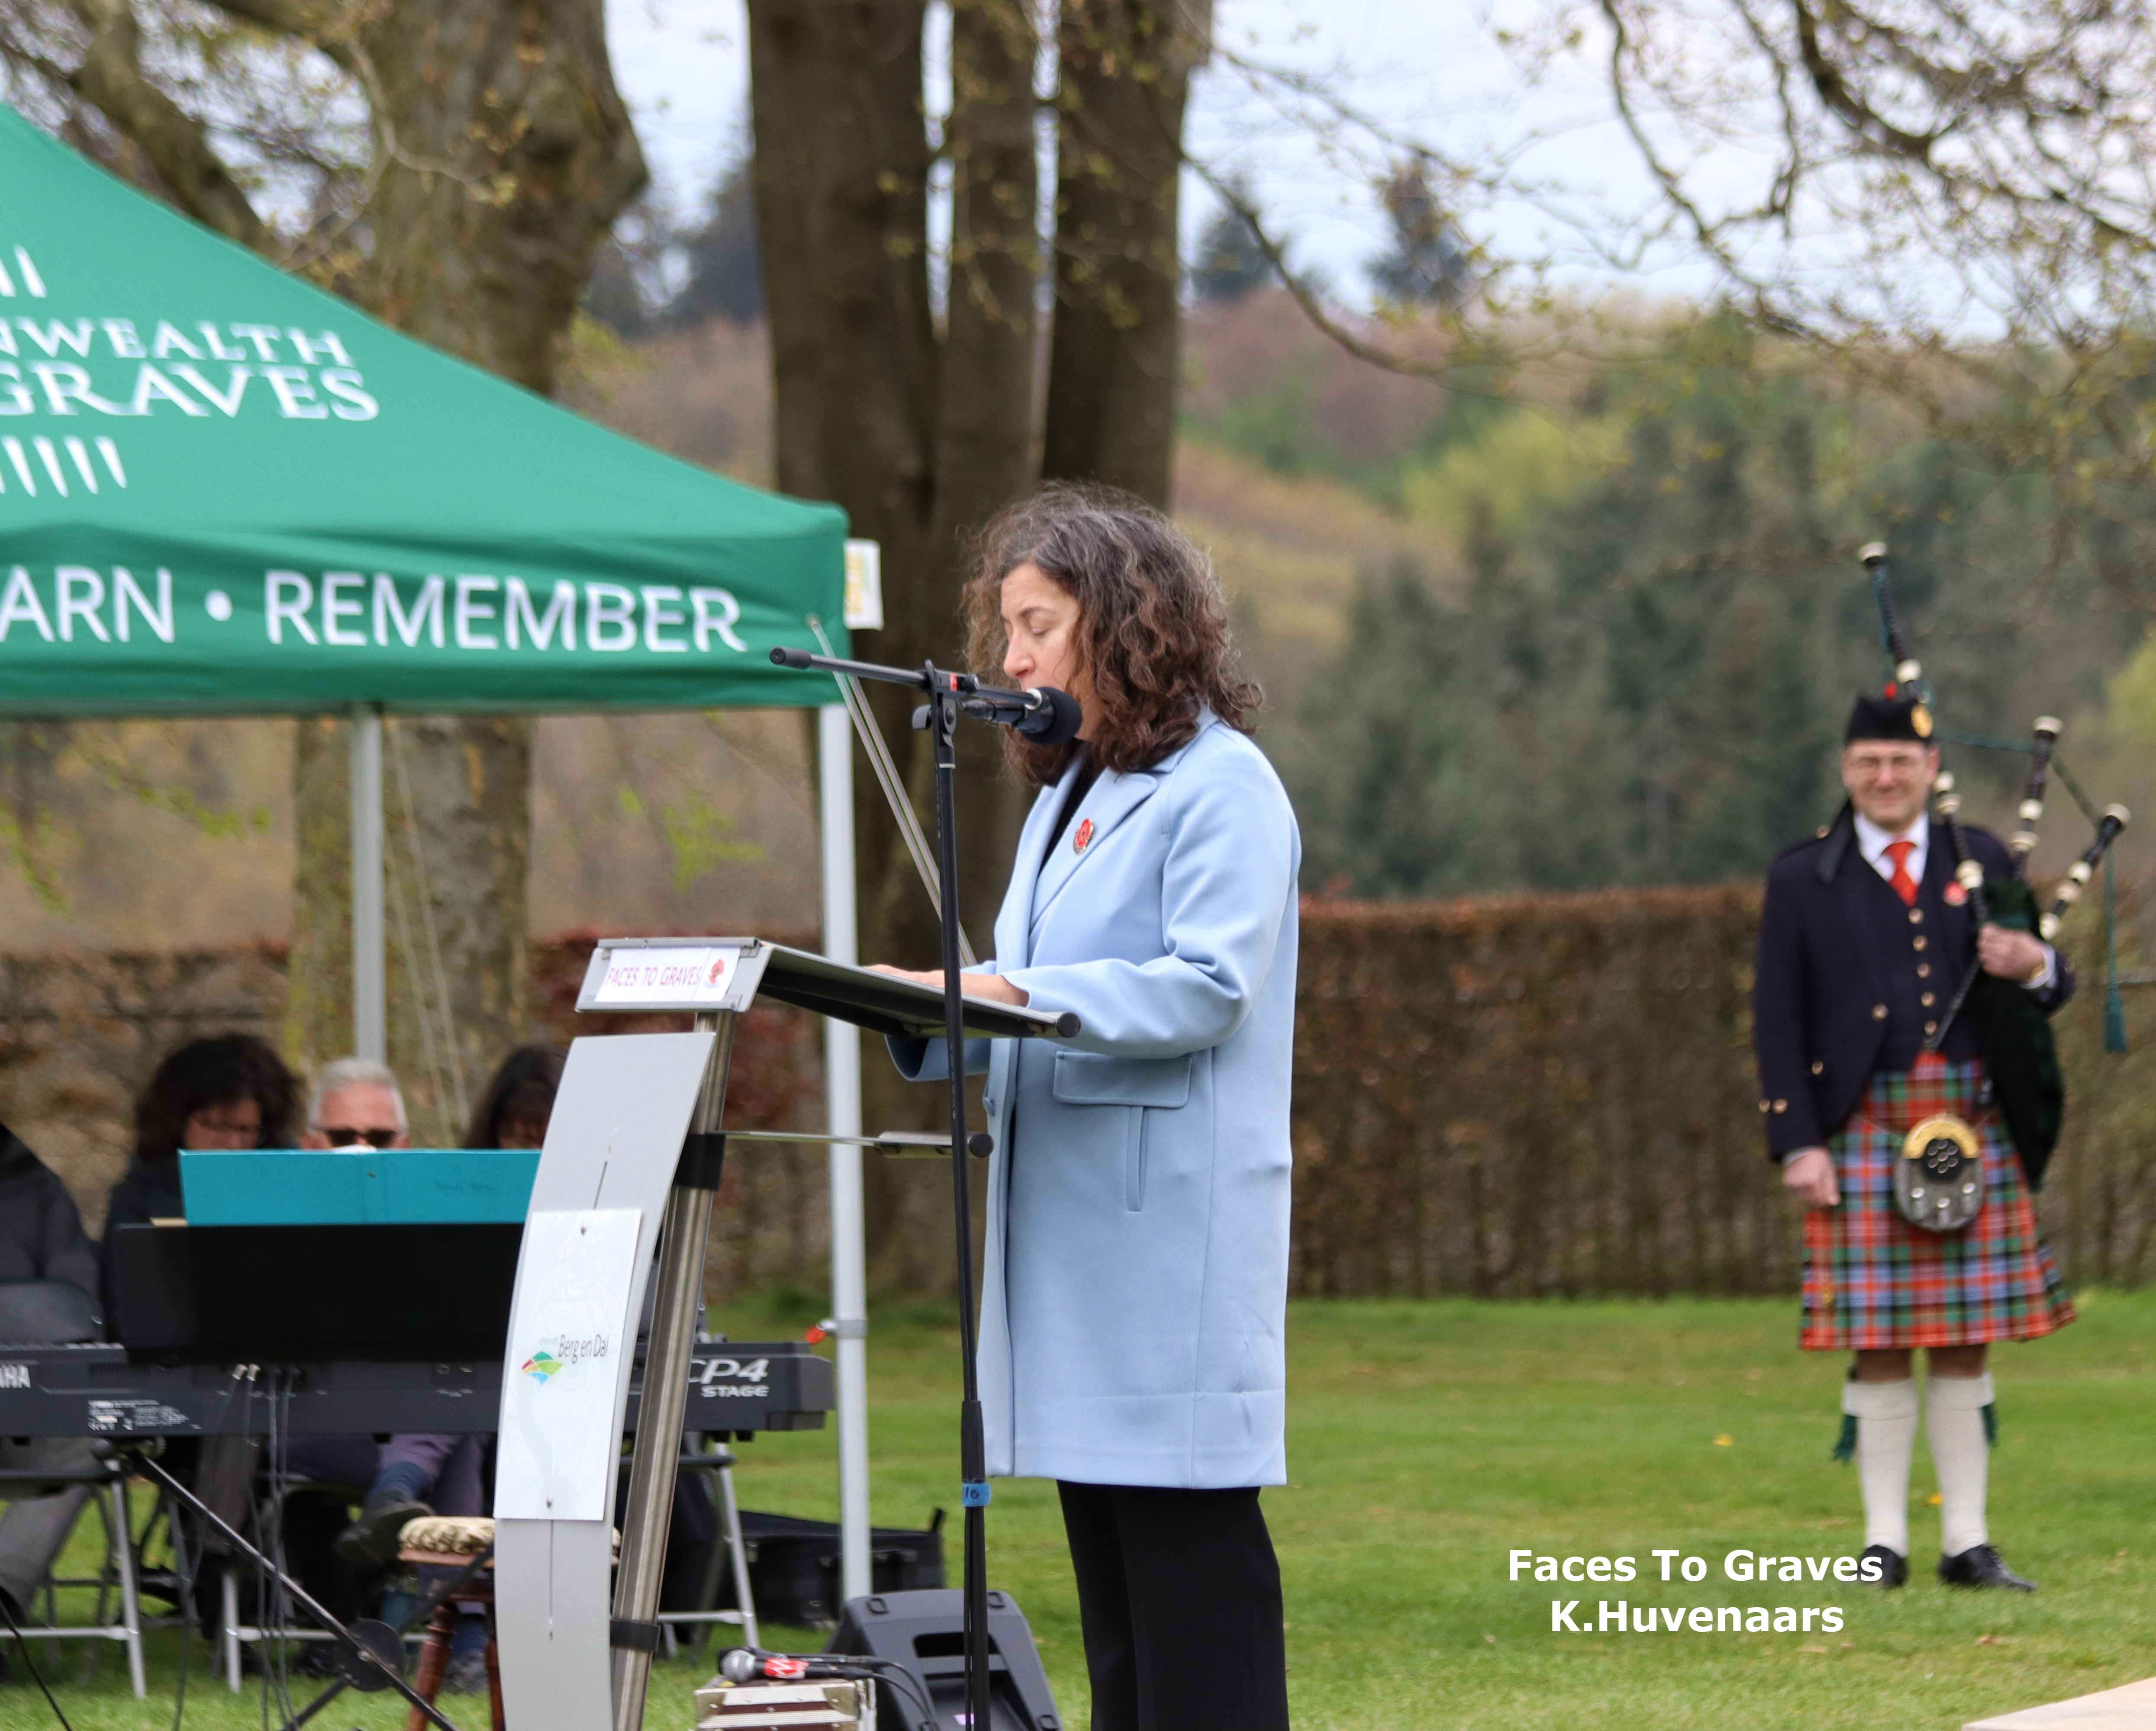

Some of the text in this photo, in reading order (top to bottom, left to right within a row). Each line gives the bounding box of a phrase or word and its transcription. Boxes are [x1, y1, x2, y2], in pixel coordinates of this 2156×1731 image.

[0, 567, 747, 653] ARN REMEMBER
[605, 966, 703, 986] FACES TO GRAVES
[558, 1334, 579, 1364] Berg
[581, 1340, 592, 1357] en
[594, 1334, 609, 1357] Dal
[700, 1385, 769, 1398] STAGE
